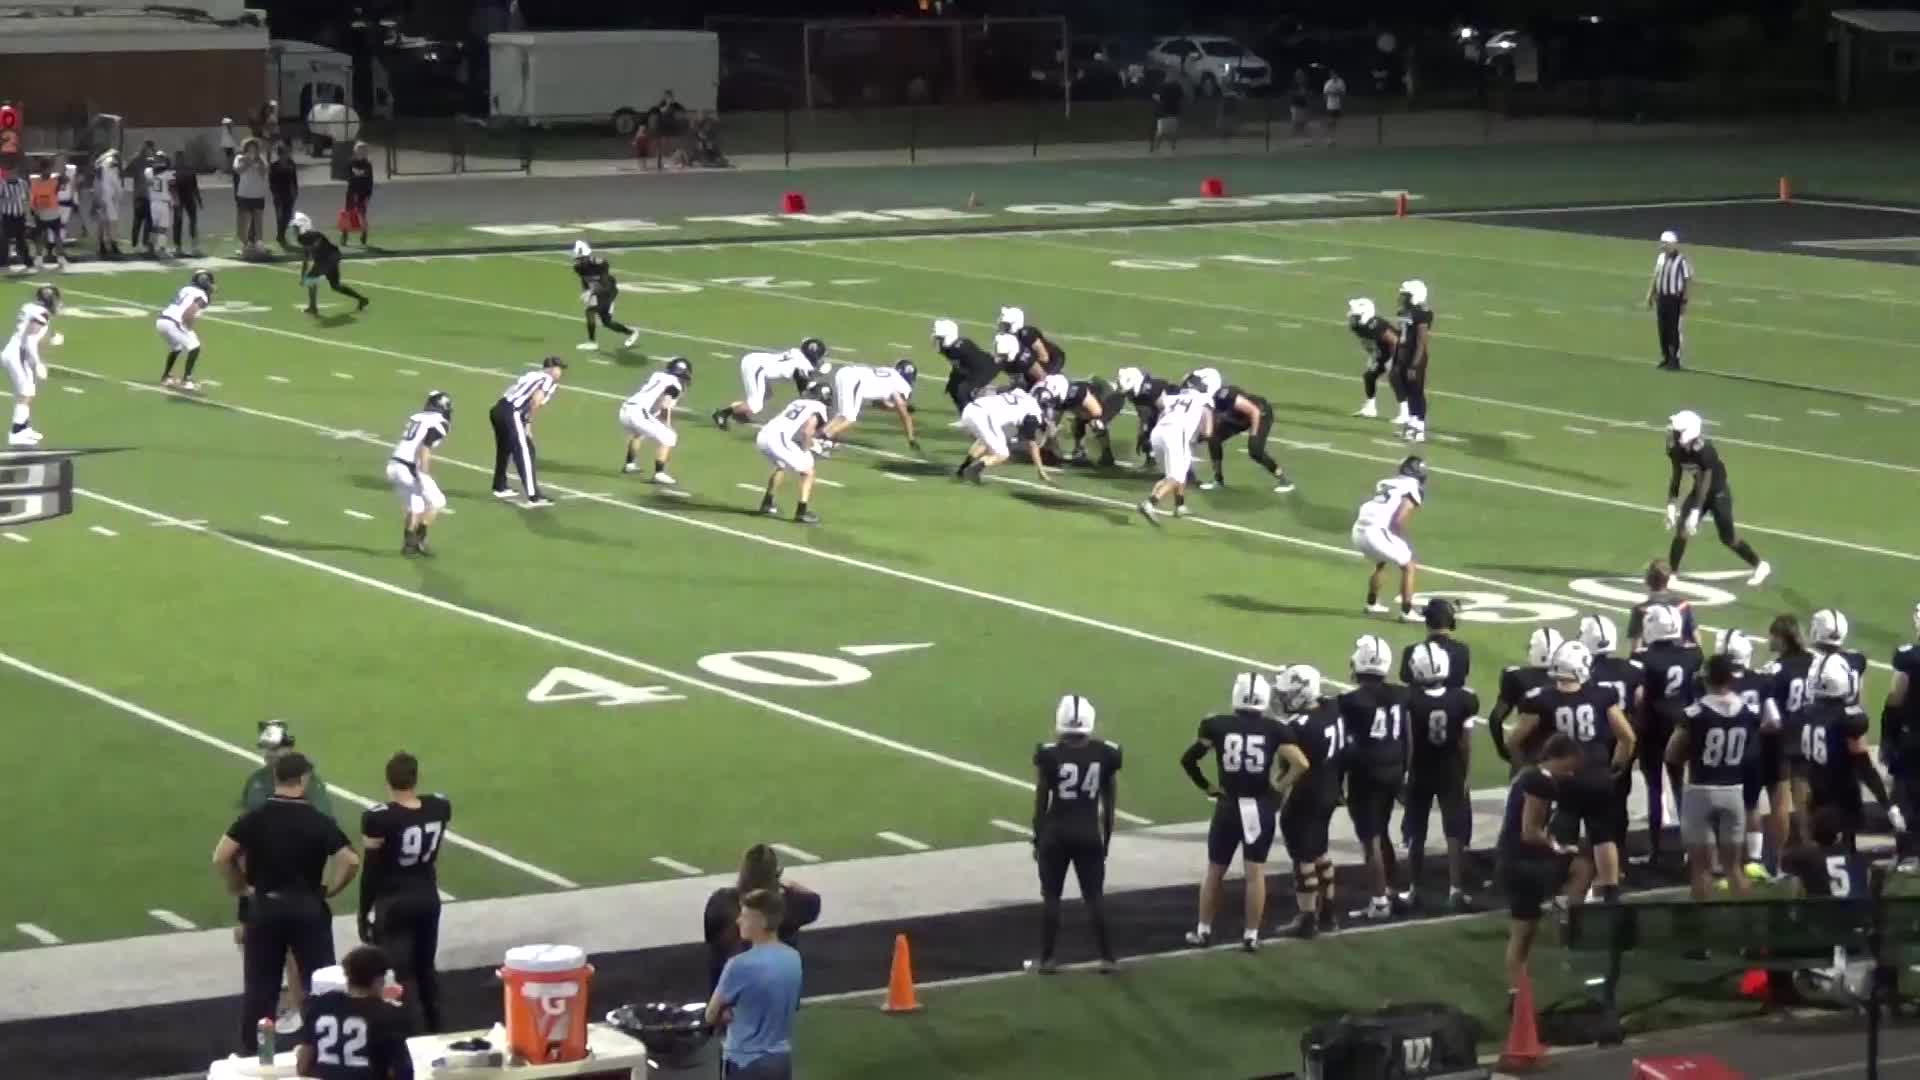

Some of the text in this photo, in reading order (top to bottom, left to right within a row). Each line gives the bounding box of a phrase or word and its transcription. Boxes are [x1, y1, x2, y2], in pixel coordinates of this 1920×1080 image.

[527, 650, 872, 706] 40
[1664, 664, 1684, 699] 2
[1323, 716, 1346, 759] 71
[1369, 703, 1401, 740] 41
[1555, 703, 1597, 742] 98
[1222, 733, 1267, 774] 85
[1703, 726, 1748, 768] 80
[1801, 723, 1828, 766] 46
[1057, 761, 1101, 800] 24
[399, 820, 443, 867] 97
[1826, 855, 1850, 898] 5
[314, 1014, 370, 1067] 22
